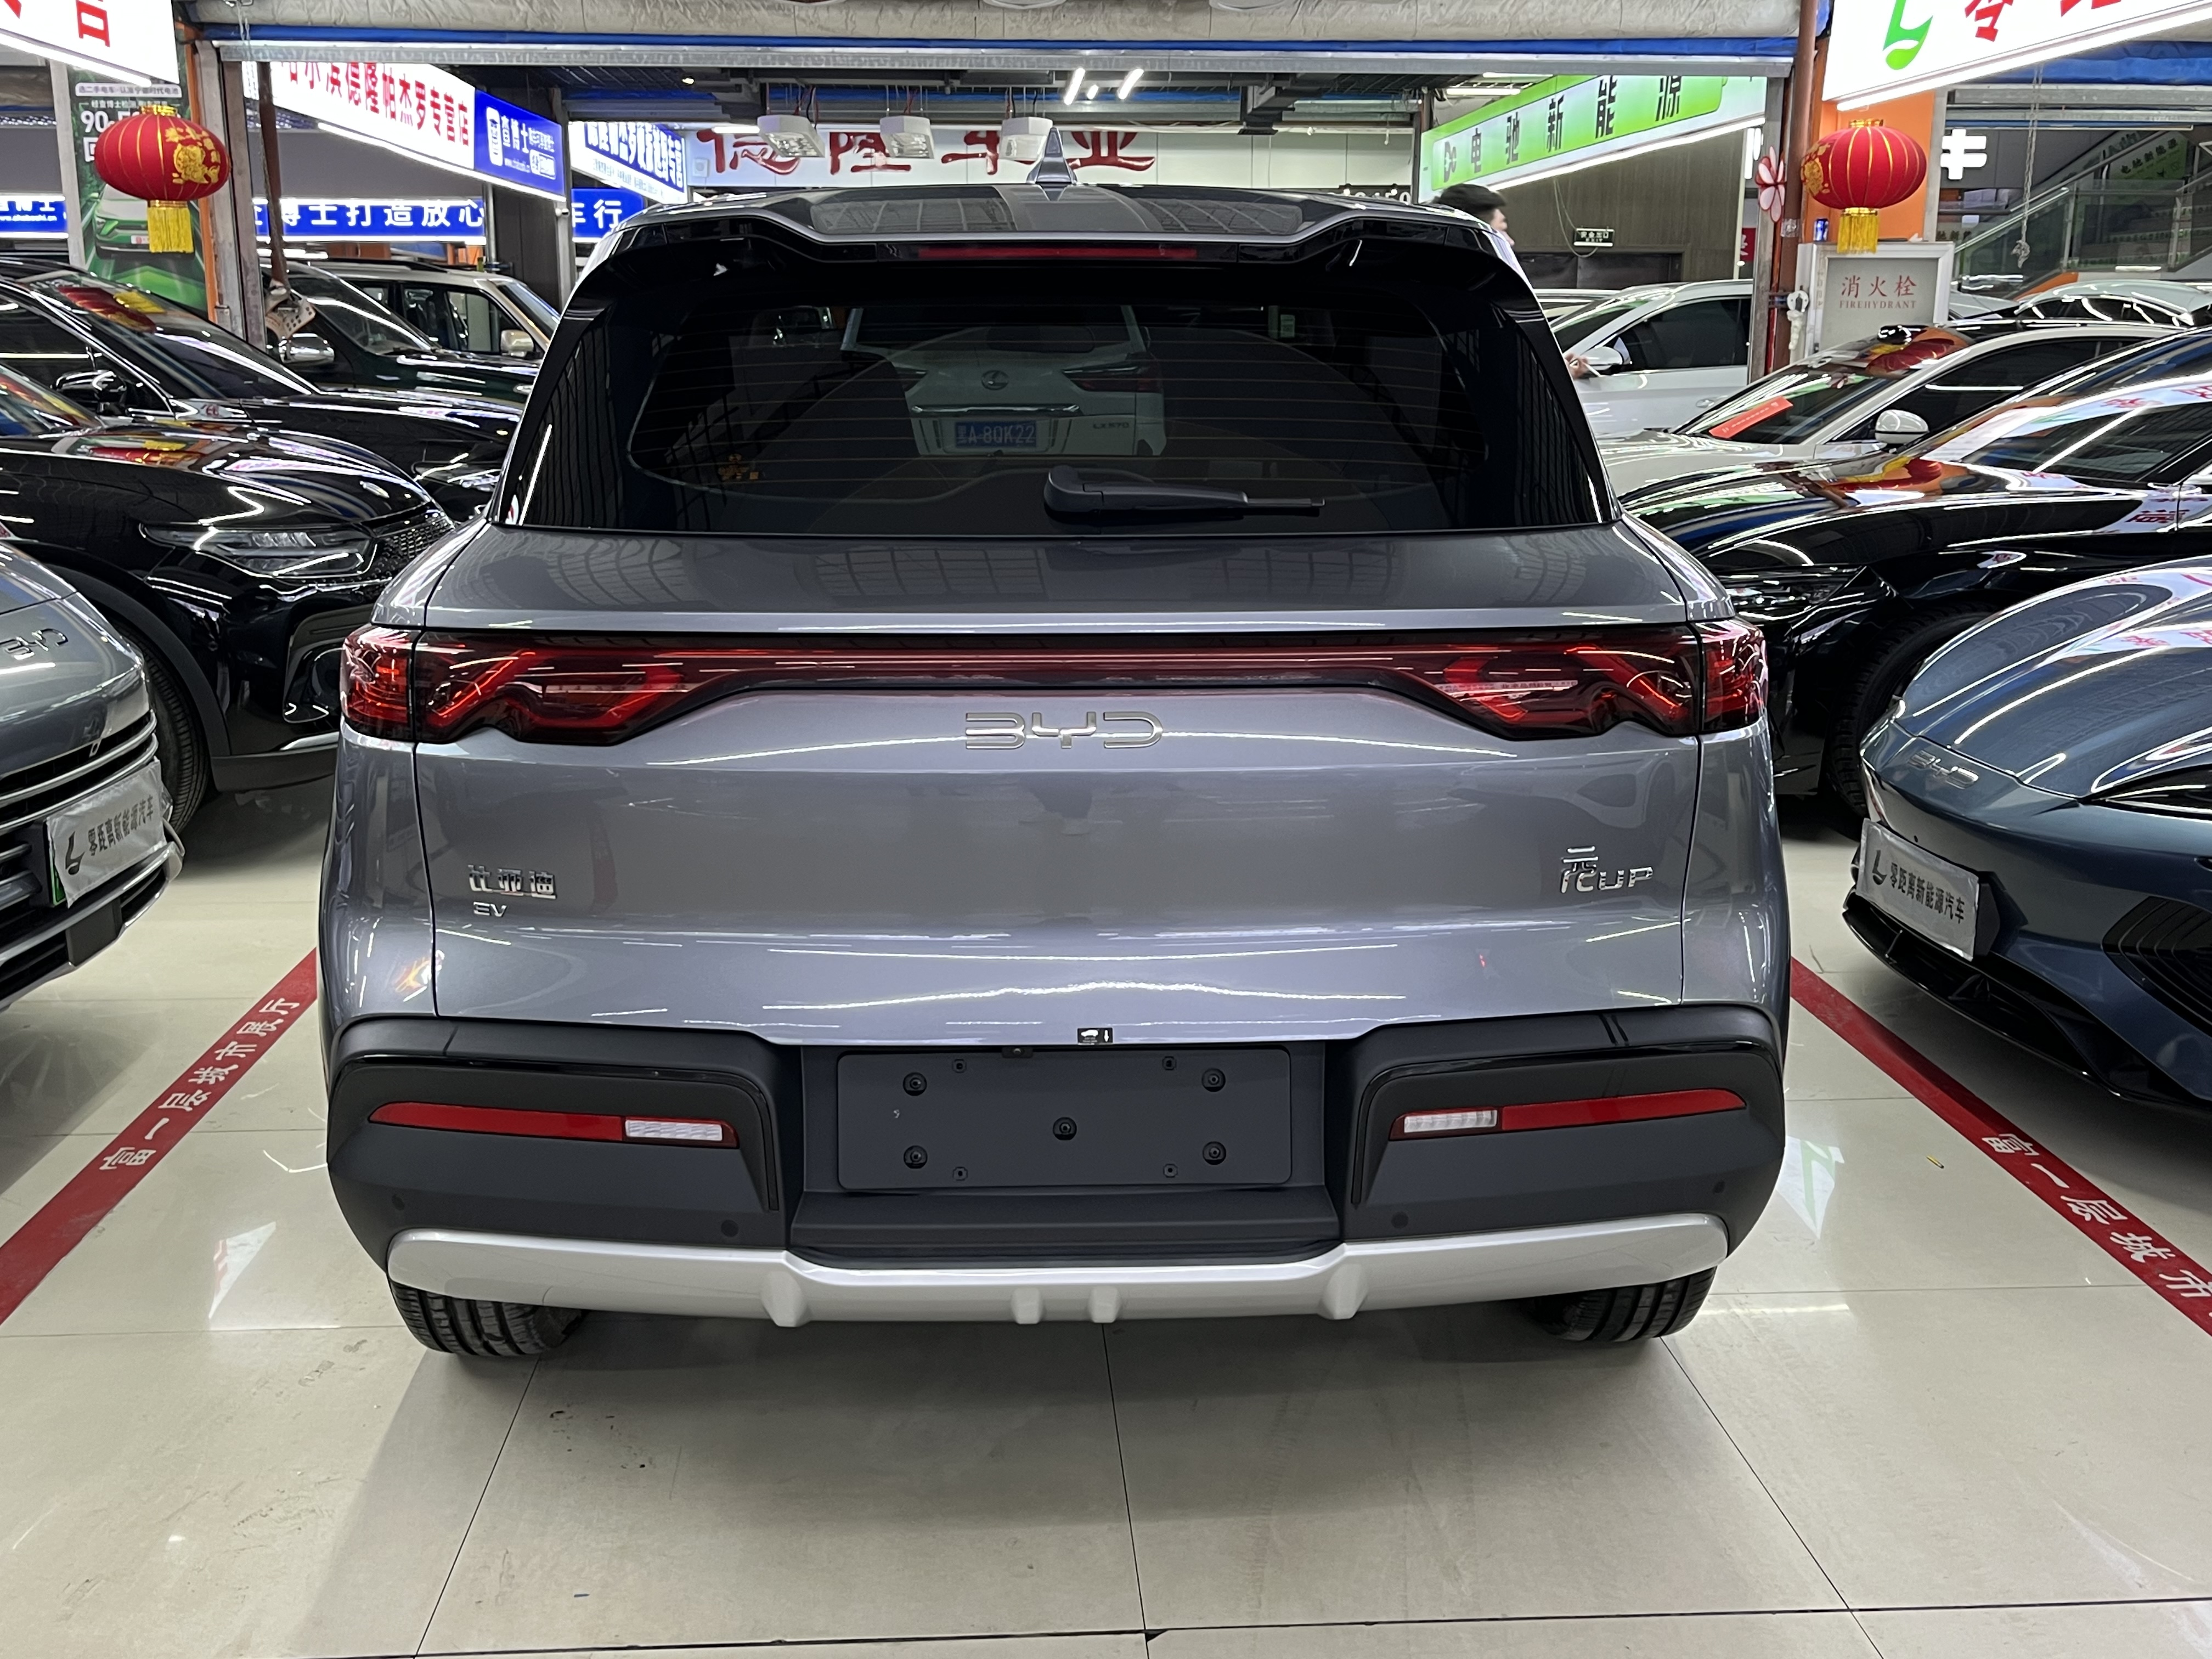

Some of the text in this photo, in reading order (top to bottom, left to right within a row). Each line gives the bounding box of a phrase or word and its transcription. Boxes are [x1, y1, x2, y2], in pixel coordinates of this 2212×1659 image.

[1471, 75, 1681, 173] 电驰新能源
[1841, 275, 1917, 298] 消火栓
[966, 711, 1163, 750] BYD
[468, 864, 557, 900] 比亚迪
[473, 901, 507, 917] EV
[99, 997, 300, 1171] 富一层城市展厅
[1982, 1133, 2212, 1318] 富一层城市
